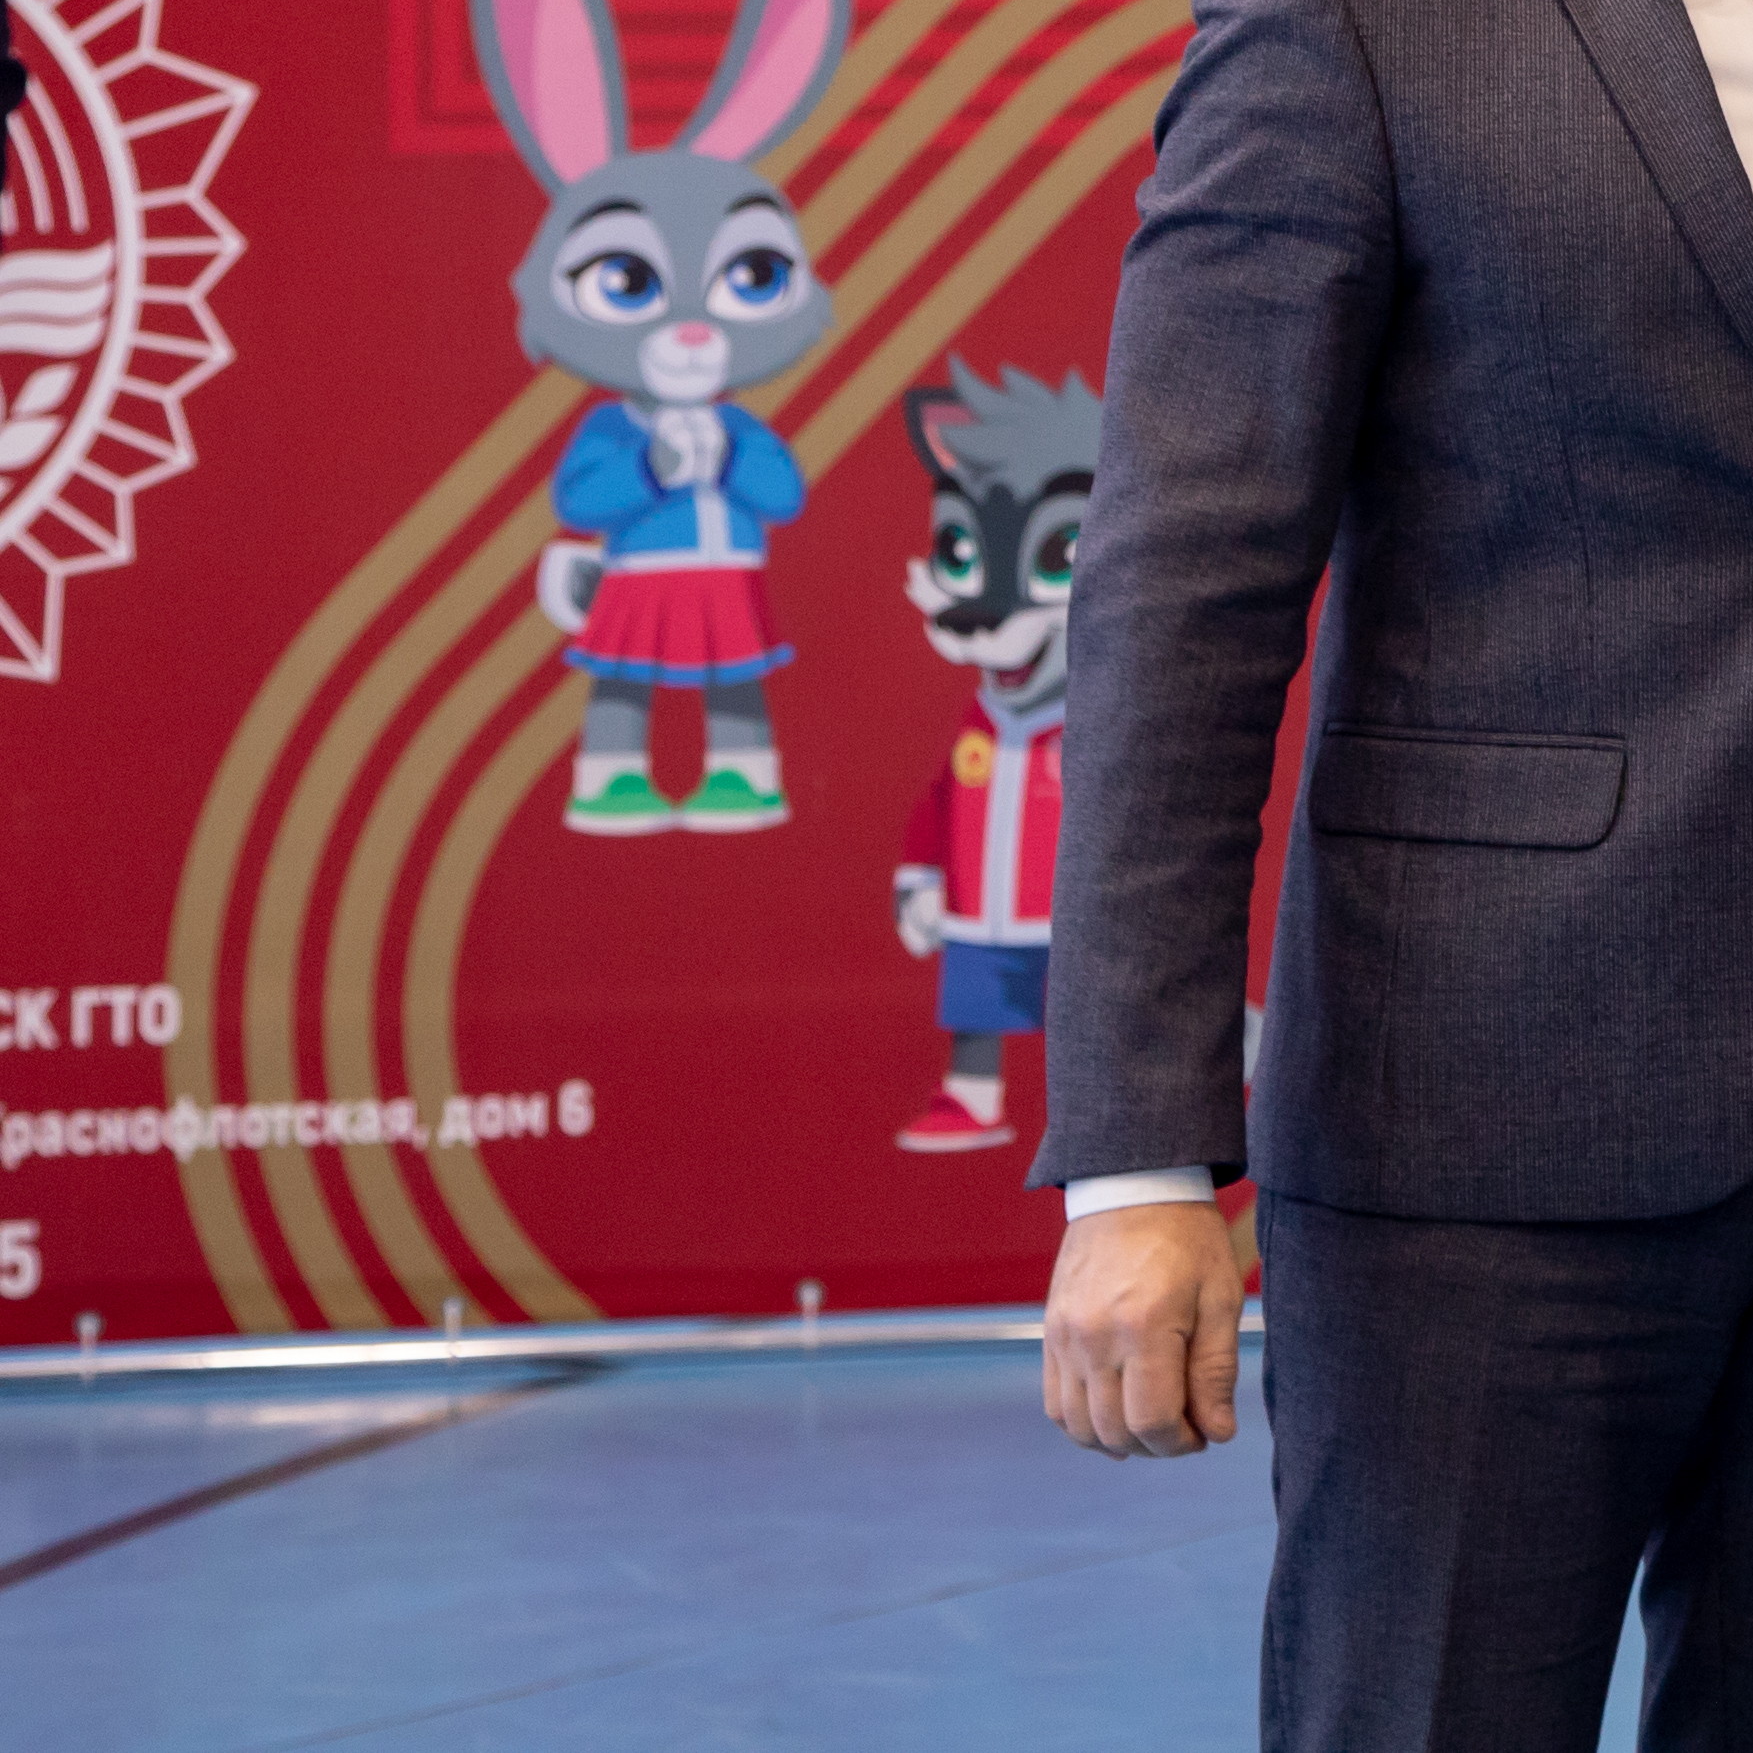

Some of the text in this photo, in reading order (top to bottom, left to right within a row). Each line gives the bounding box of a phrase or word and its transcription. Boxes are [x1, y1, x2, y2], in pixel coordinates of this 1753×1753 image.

[70, 983, 183, 1048] ГТО
[0, 1079, 595, 1171] раснофлотская, дом 6
[0, 1219, 41, 1300] 5
